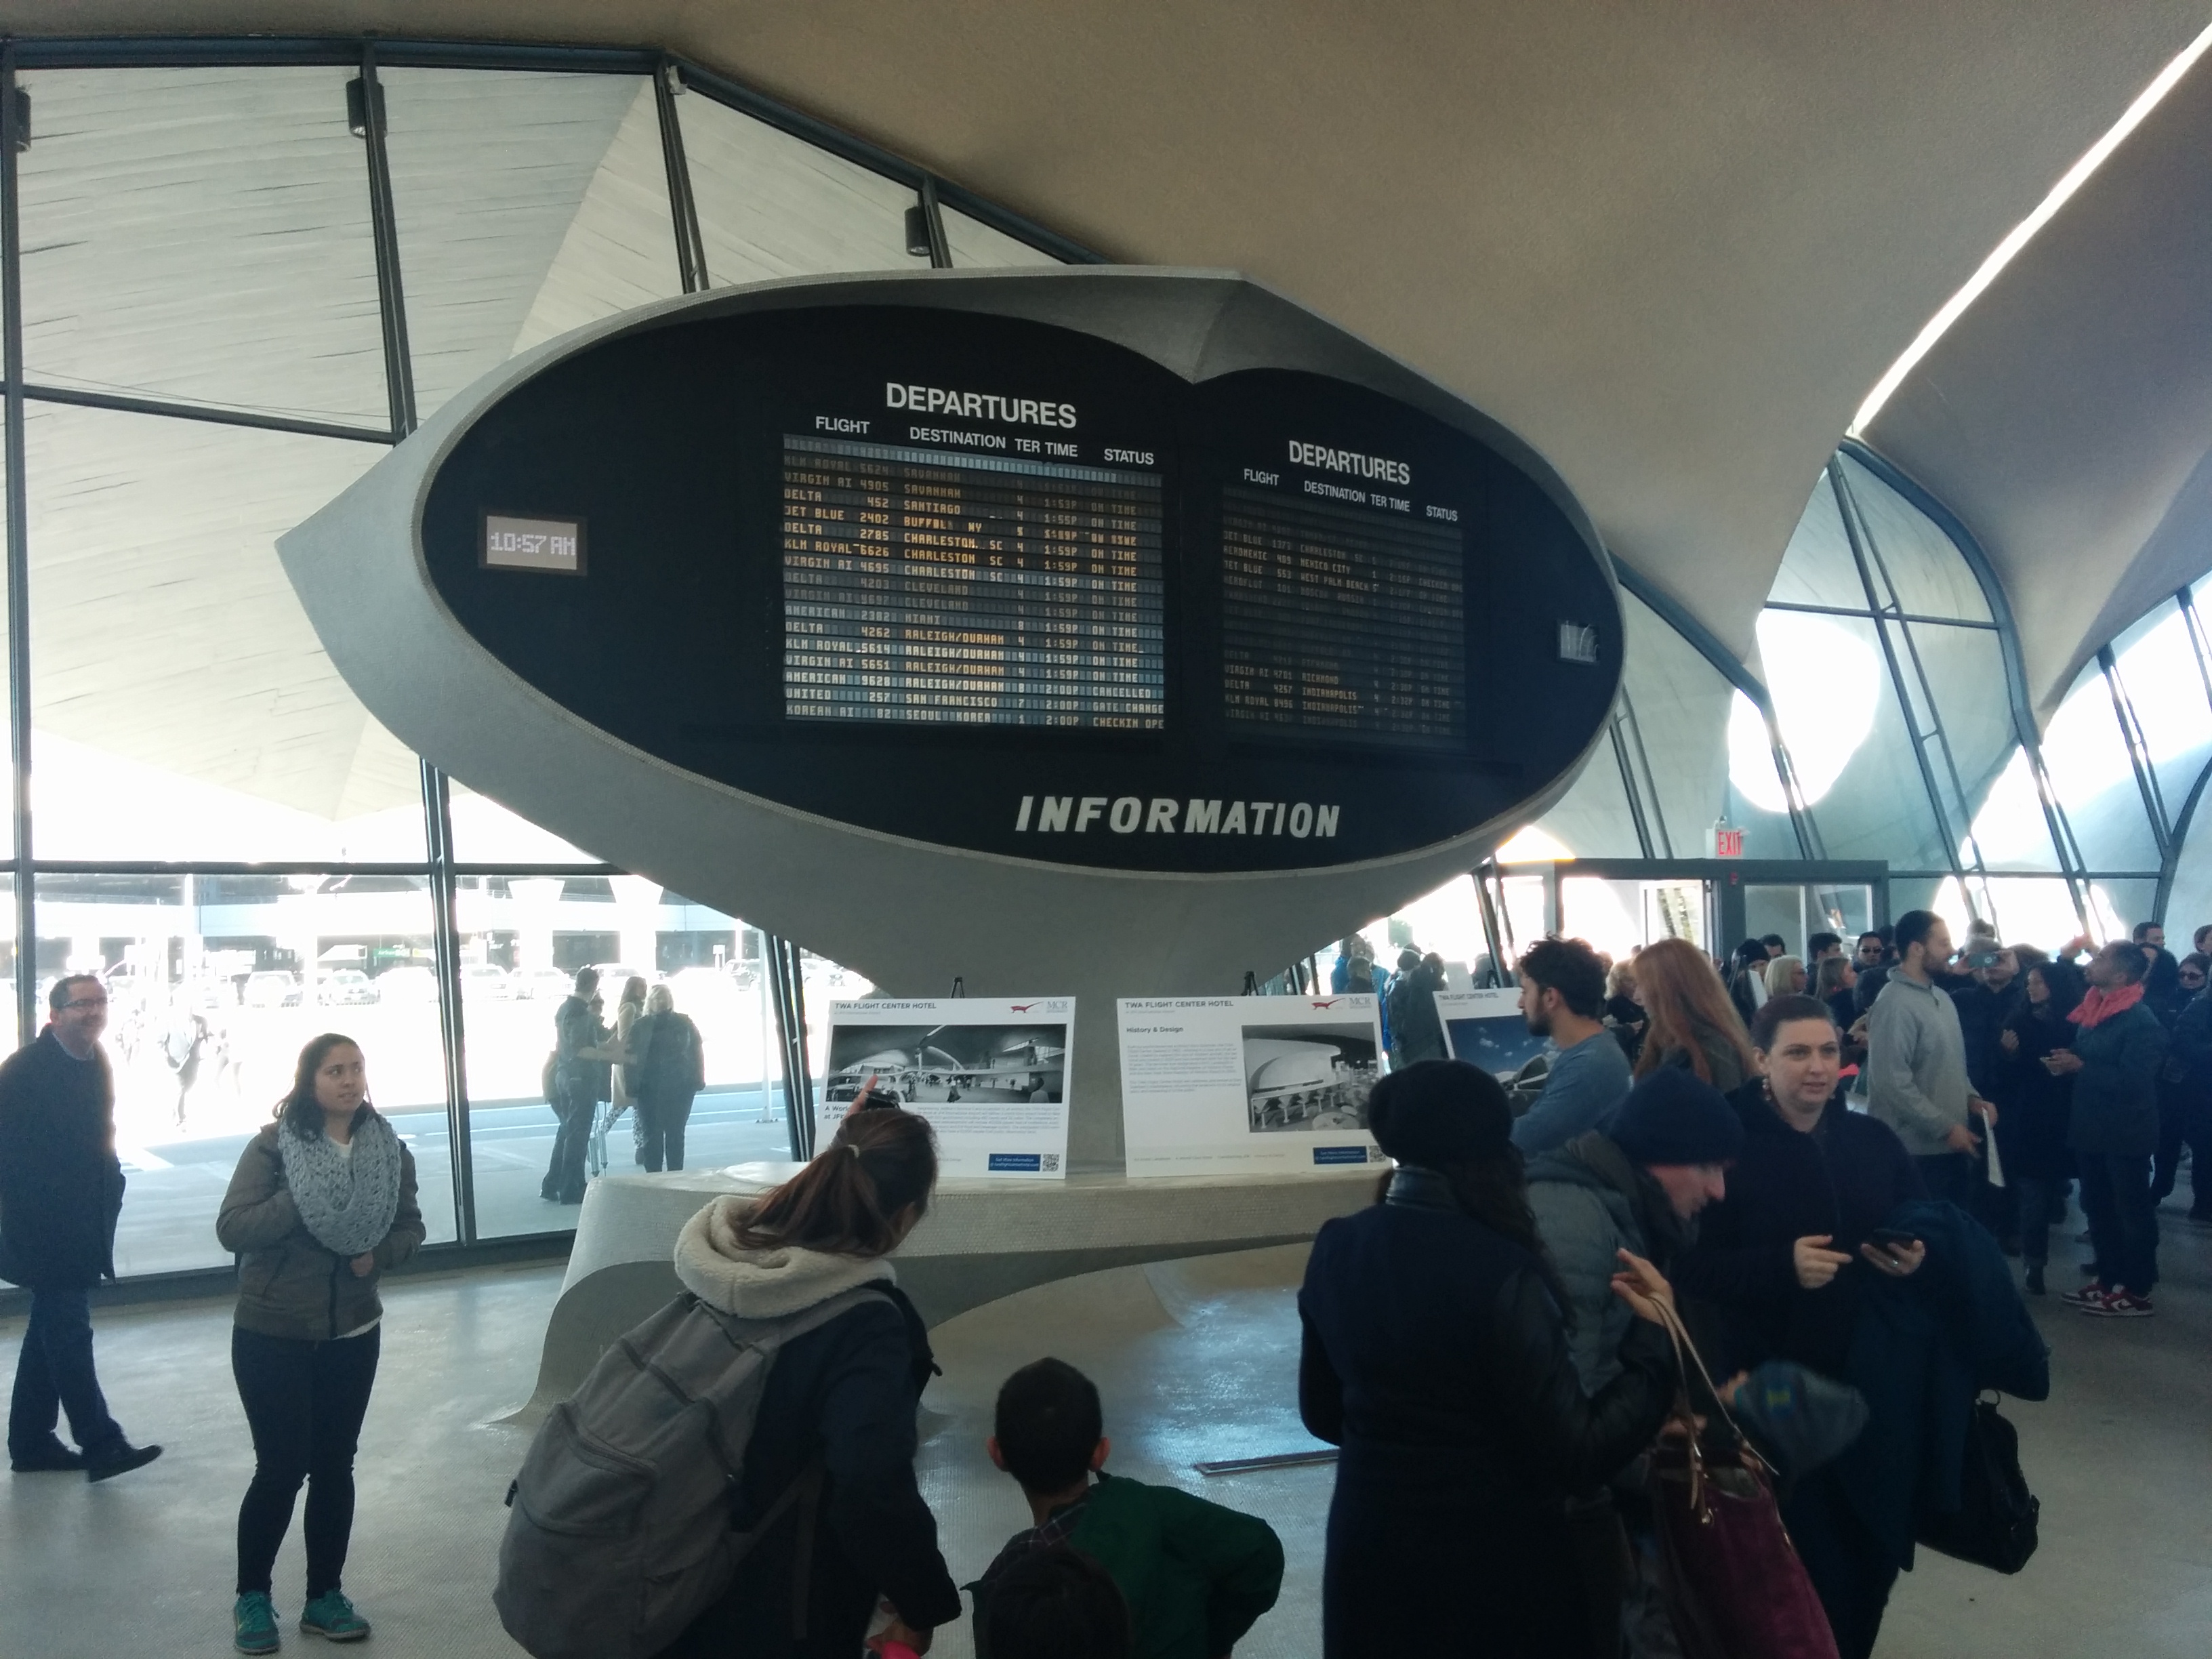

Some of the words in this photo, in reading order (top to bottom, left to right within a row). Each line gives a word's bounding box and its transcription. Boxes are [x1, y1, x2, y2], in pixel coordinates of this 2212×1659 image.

[885, 382, 1078, 428] DEPARTURES
[815, 415, 870, 434] FLIGHT
[910, 426, 1006, 449] DESTINATION
[1015, 438, 1040, 453] TER
[1044, 441, 1078, 457] TIME
[1104, 448, 1155, 466] STATUS
[1289, 440, 1410, 485] DEPARTURES
[783, 472, 830, 486] VIRGIN
[837, 477, 852, 488] AI
[859, 479, 888, 492] 4905
[904, 483, 961, 499] SAVANNAH
[1091, 502, 1104, 512] ON
[1111, 504, 1136, 516] TIME
[1244, 468, 1279, 486] FLIGHT
[1304, 480, 1366, 504] DESTINATION
[1370, 493, 1387, 508] TER
[1389, 497, 1410, 512] TIME
[1426, 505, 1458, 522] STATUS
[784, 488, 822, 502] DELTA
[867, 496, 889, 508] 452
[904, 499, 961, 515] SANTIAGO
[1044, 513, 1078, 525] 1:55P
[1091, 517, 1104, 528] ON
[1111, 519, 1136, 531] TIME
[784, 505, 806, 517] JET
[815, 508, 844, 520] BLUE
[860, 512, 889, 525] 2402
[491, 532, 546, 554] 10:57
[550, 536, 575, 556] AM
[784, 522, 822, 535] DELTA
[860, 528, 889, 541] 2785
[904, 532, 975, 548] CHARLESTON
[989, 539, 1003, 550] SC
[1017, 541, 1024, 552] 4
[1044, 544, 1078, 556] 1:59P
[1091, 548, 1104, 558] ON
[1111, 550, 1136, 561] TIME
[784, 538, 807, 550] KLM
[815, 541, 852, 554] ROYAL
[860, 544, 889, 557] 6626
[904, 548, 975, 564] CHARLESTON
[989, 555, 1003, 566] SC
[1017, 557, 1024, 567] 4
[1044, 560, 1078, 572] 1:59P
[1092, 563, 1105, 574] ON
[1111, 565, 1137, 577] TIME
[1243, 562, 1263, 575] BLUE
[1333, 562, 1351, 575] CITY
[784, 555, 830, 569] VIRGIN
[838, 559, 853, 570] AI
[860, 561, 889, 573] 4695
[904, 565, 975, 579] CHARLESTON
[989, 571, 1003, 581] SC
[1017, 573, 1024, 583] 4
[1045, 575, 1078, 587] 1:59P
[1092, 579, 1105, 589] ON
[1111, 580, 1137, 592] TIME
[785, 571, 822, 584] DELTA
[905, 580, 968, 595] CLEVELAND
[785, 605, 845, 619] AMERICAN
[905, 613, 941, 625] MIAMI
[1045, 621, 1078, 634] 1:59P
[1092, 625, 1105, 635] ON
[1111, 626, 1137, 637] TIME
[785, 621, 823, 634] DELTA
[861, 626, 890, 638] 4262
[905, 629, 1004, 644] RALEIGH/DURHAM
[1018, 636, 1025, 646] 4
[1045, 637, 1078, 649] 1:59P
[1092, 640, 1105, 651] ON
[1111, 641, 1137, 652] TIME
[785, 638, 808, 650] KLM
[815, 640, 853, 652] ROYAL
[861, 642, 890, 654] 5614
[905, 645, 1004, 660] RALEIGH/DURHAM
[1045, 653, 1078, 664] 1:59P
[1092, 655, 1105, 665] ON
[1111, 657, 1137, 668] TIME
[785, 655, 830, 668] VIRGIN
[838, 658, 853, 668] AI
[861, 659, 890, 670] 5651
[905, 661, 1004, 676] RALEIGH/DURHAM
[1045, 668, 1078, 680] 1:59P
[1092, 671, 1105, 681] ON
[1111, 672, 1137, 682] TIME
[785, 672, 846, 684] AMERICAN
[905, 677, 1004, 692] RALEIGH/DURHAM
[1046, 684, 1079, 695] 2:00P
[1092, 686, 1150, 698] CANCELLED
[1302, 686, 1357, 701] INDIANAPOLIS
[785, 689, 831, 700] UNITED
[868, 692, 890, 703] 257
[905, 693, 926, 704] SAN
[934, 695, 997, 707] FRANCISCO
[1046, 699, 1079, 710] 2:00P
[1092, 701, 1118, 712] GATE
[1125, 703, 1163, 714] CHANGE
[785, 705, 831, 717] KOREAN
[839, 707, 853, 718] AI
[905, 710, 941, 721] SEOUL
[956, 712, 990, 722] KOREA
[1019, 714, 1025, 724] 1
[1046, 715, 1079, 726] 2:00P
[1092, 717, 1138, 728] CHECKIN
[1244, 695, 1269, 707] ROYAL
[1302, 700, 1357, 714] INDIANAPOLIS
[1016, 796, 1340, 838] INFORMATION
[1718, 832, 1741, 856] EXIT
